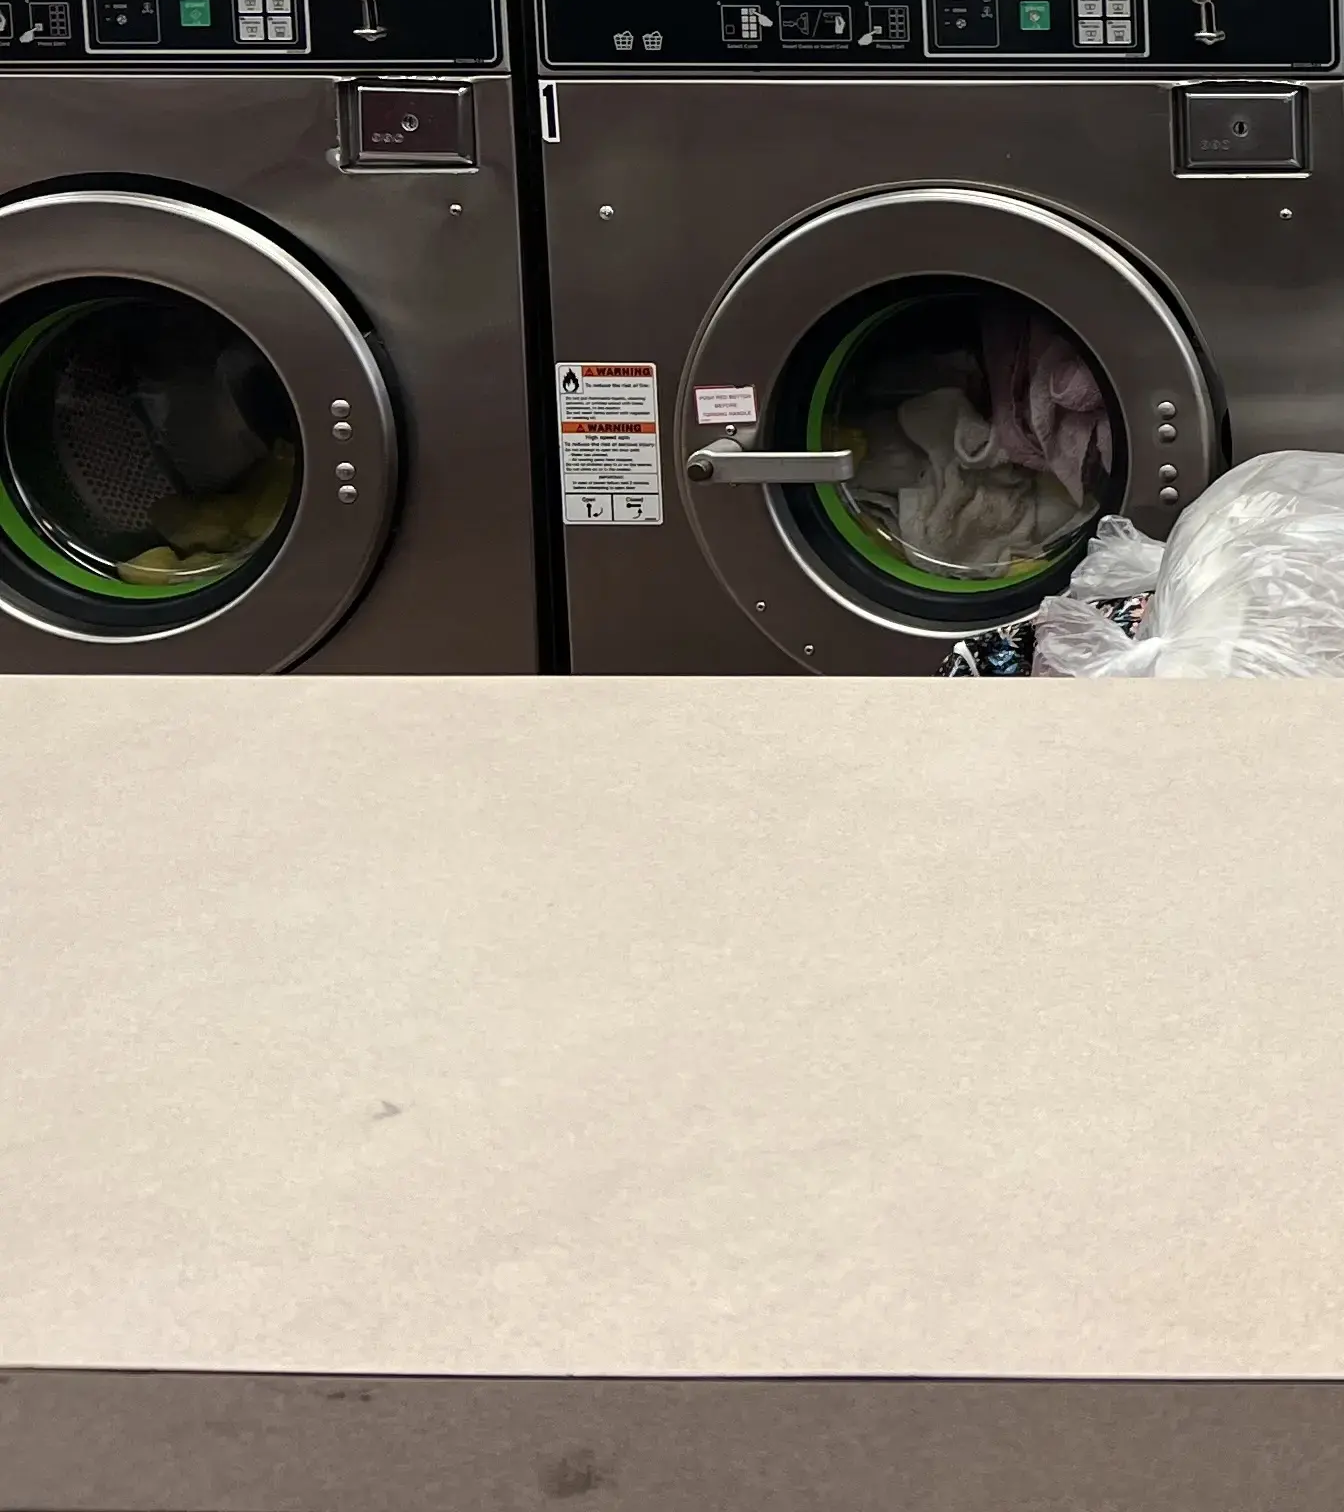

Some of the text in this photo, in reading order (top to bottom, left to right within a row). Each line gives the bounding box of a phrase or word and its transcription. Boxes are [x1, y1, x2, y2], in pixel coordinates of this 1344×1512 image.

[543, 84, 557, 138] 1
[594, 367, 651, 377] WARNING
[587, 423, 642, 433] WARNING
